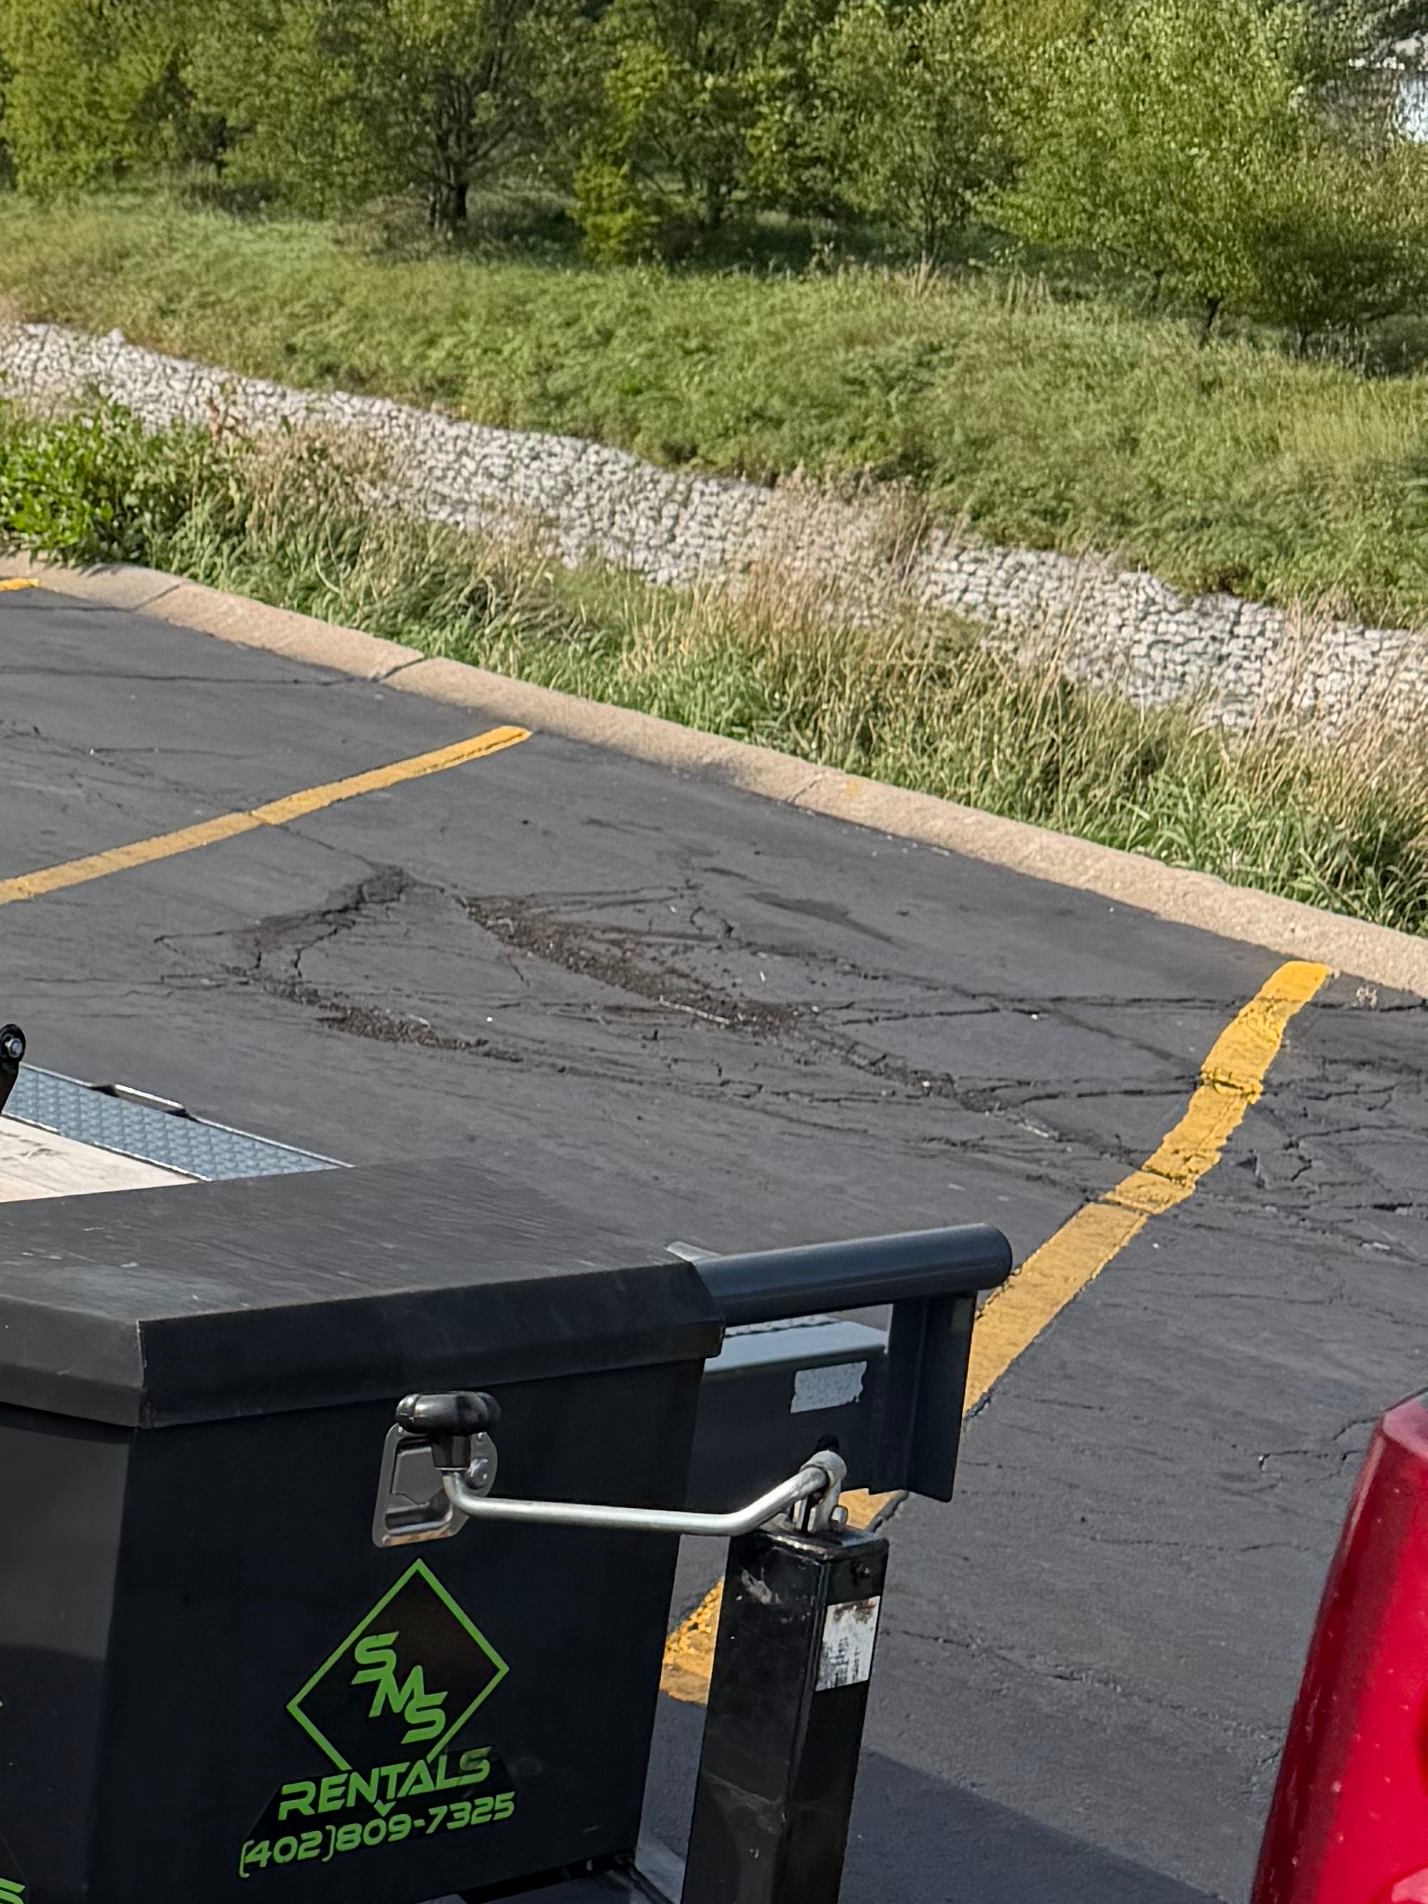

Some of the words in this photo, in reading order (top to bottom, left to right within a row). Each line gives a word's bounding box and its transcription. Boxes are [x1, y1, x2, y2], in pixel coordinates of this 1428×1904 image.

[351, 1631, 448, 1744] SMS
[278, 1746, 493, 1821] RENTALS
[239, 1792, 516, 1878] (402)809-7325
